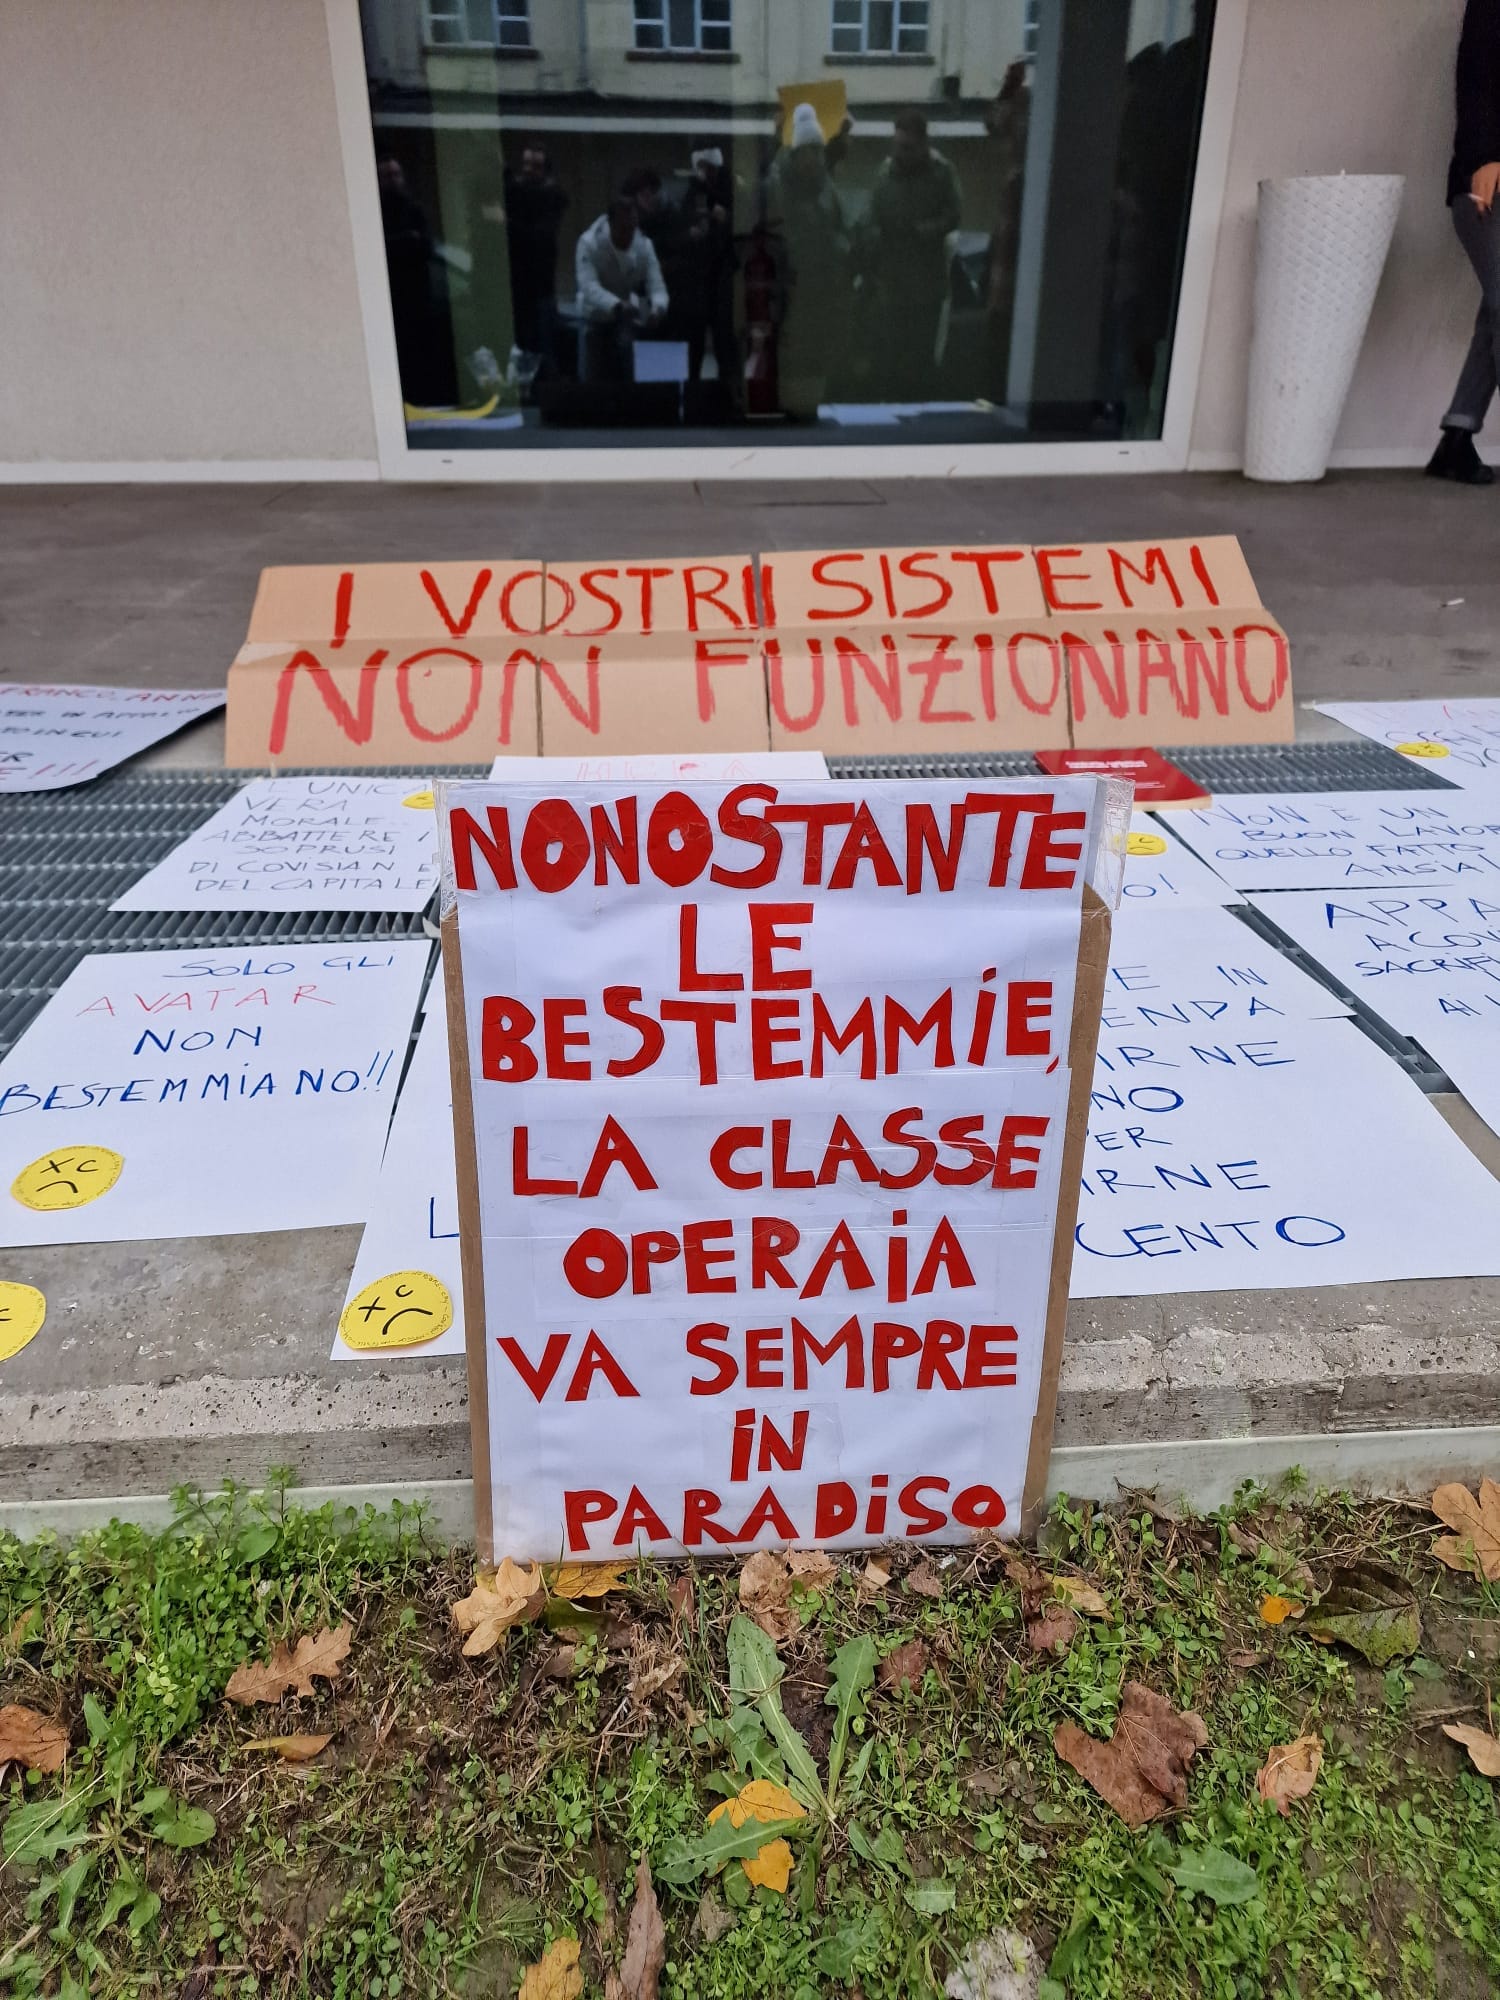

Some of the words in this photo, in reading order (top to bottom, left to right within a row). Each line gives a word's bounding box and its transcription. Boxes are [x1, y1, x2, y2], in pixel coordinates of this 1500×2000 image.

[330, 571, 354, 648] I
[420, 565, 776, 639] VOSTRI
[807, 545, 1220, 620] SISTEMI
[268, 645, 602, 754] NON
[694, 624, 1290, 733] FUNZIONANO
[246, 796, 347, 811] VERA
[1190, 805, 1311, 826] NON
[1378, 807, 1449, 819] UN
[450, 783, 1086, 894] NONOSTANTE
[1241, 829, 1356, 842] BUON
[233, 844, 396, 855] SOPRUSI
[1215, 847, 1352, 860] QUELLO
[1365, 843, 1485, 857] FATTO
[188, 861, 219, 874] DI
[194, 879, 255, 892] DEL
[678, 903, 814, 992] LE
[162, 959, 295, 978] SOLO
[323, 955, 394, 970] GLI
[1217, 965, 1269, 986] IN
[75, 985, 337, 1017] AVATAR
[133, 1026, 262, 1055] NON
[1086, 1127, 1173, 1151] ER
[512, 1114, 659, 1198] LA
[709, 1107, 1050, 1190] CLASSE
[496, 1329, 640, 1403] VA
[685, 1315, 1018, 1395] SEMPRE
